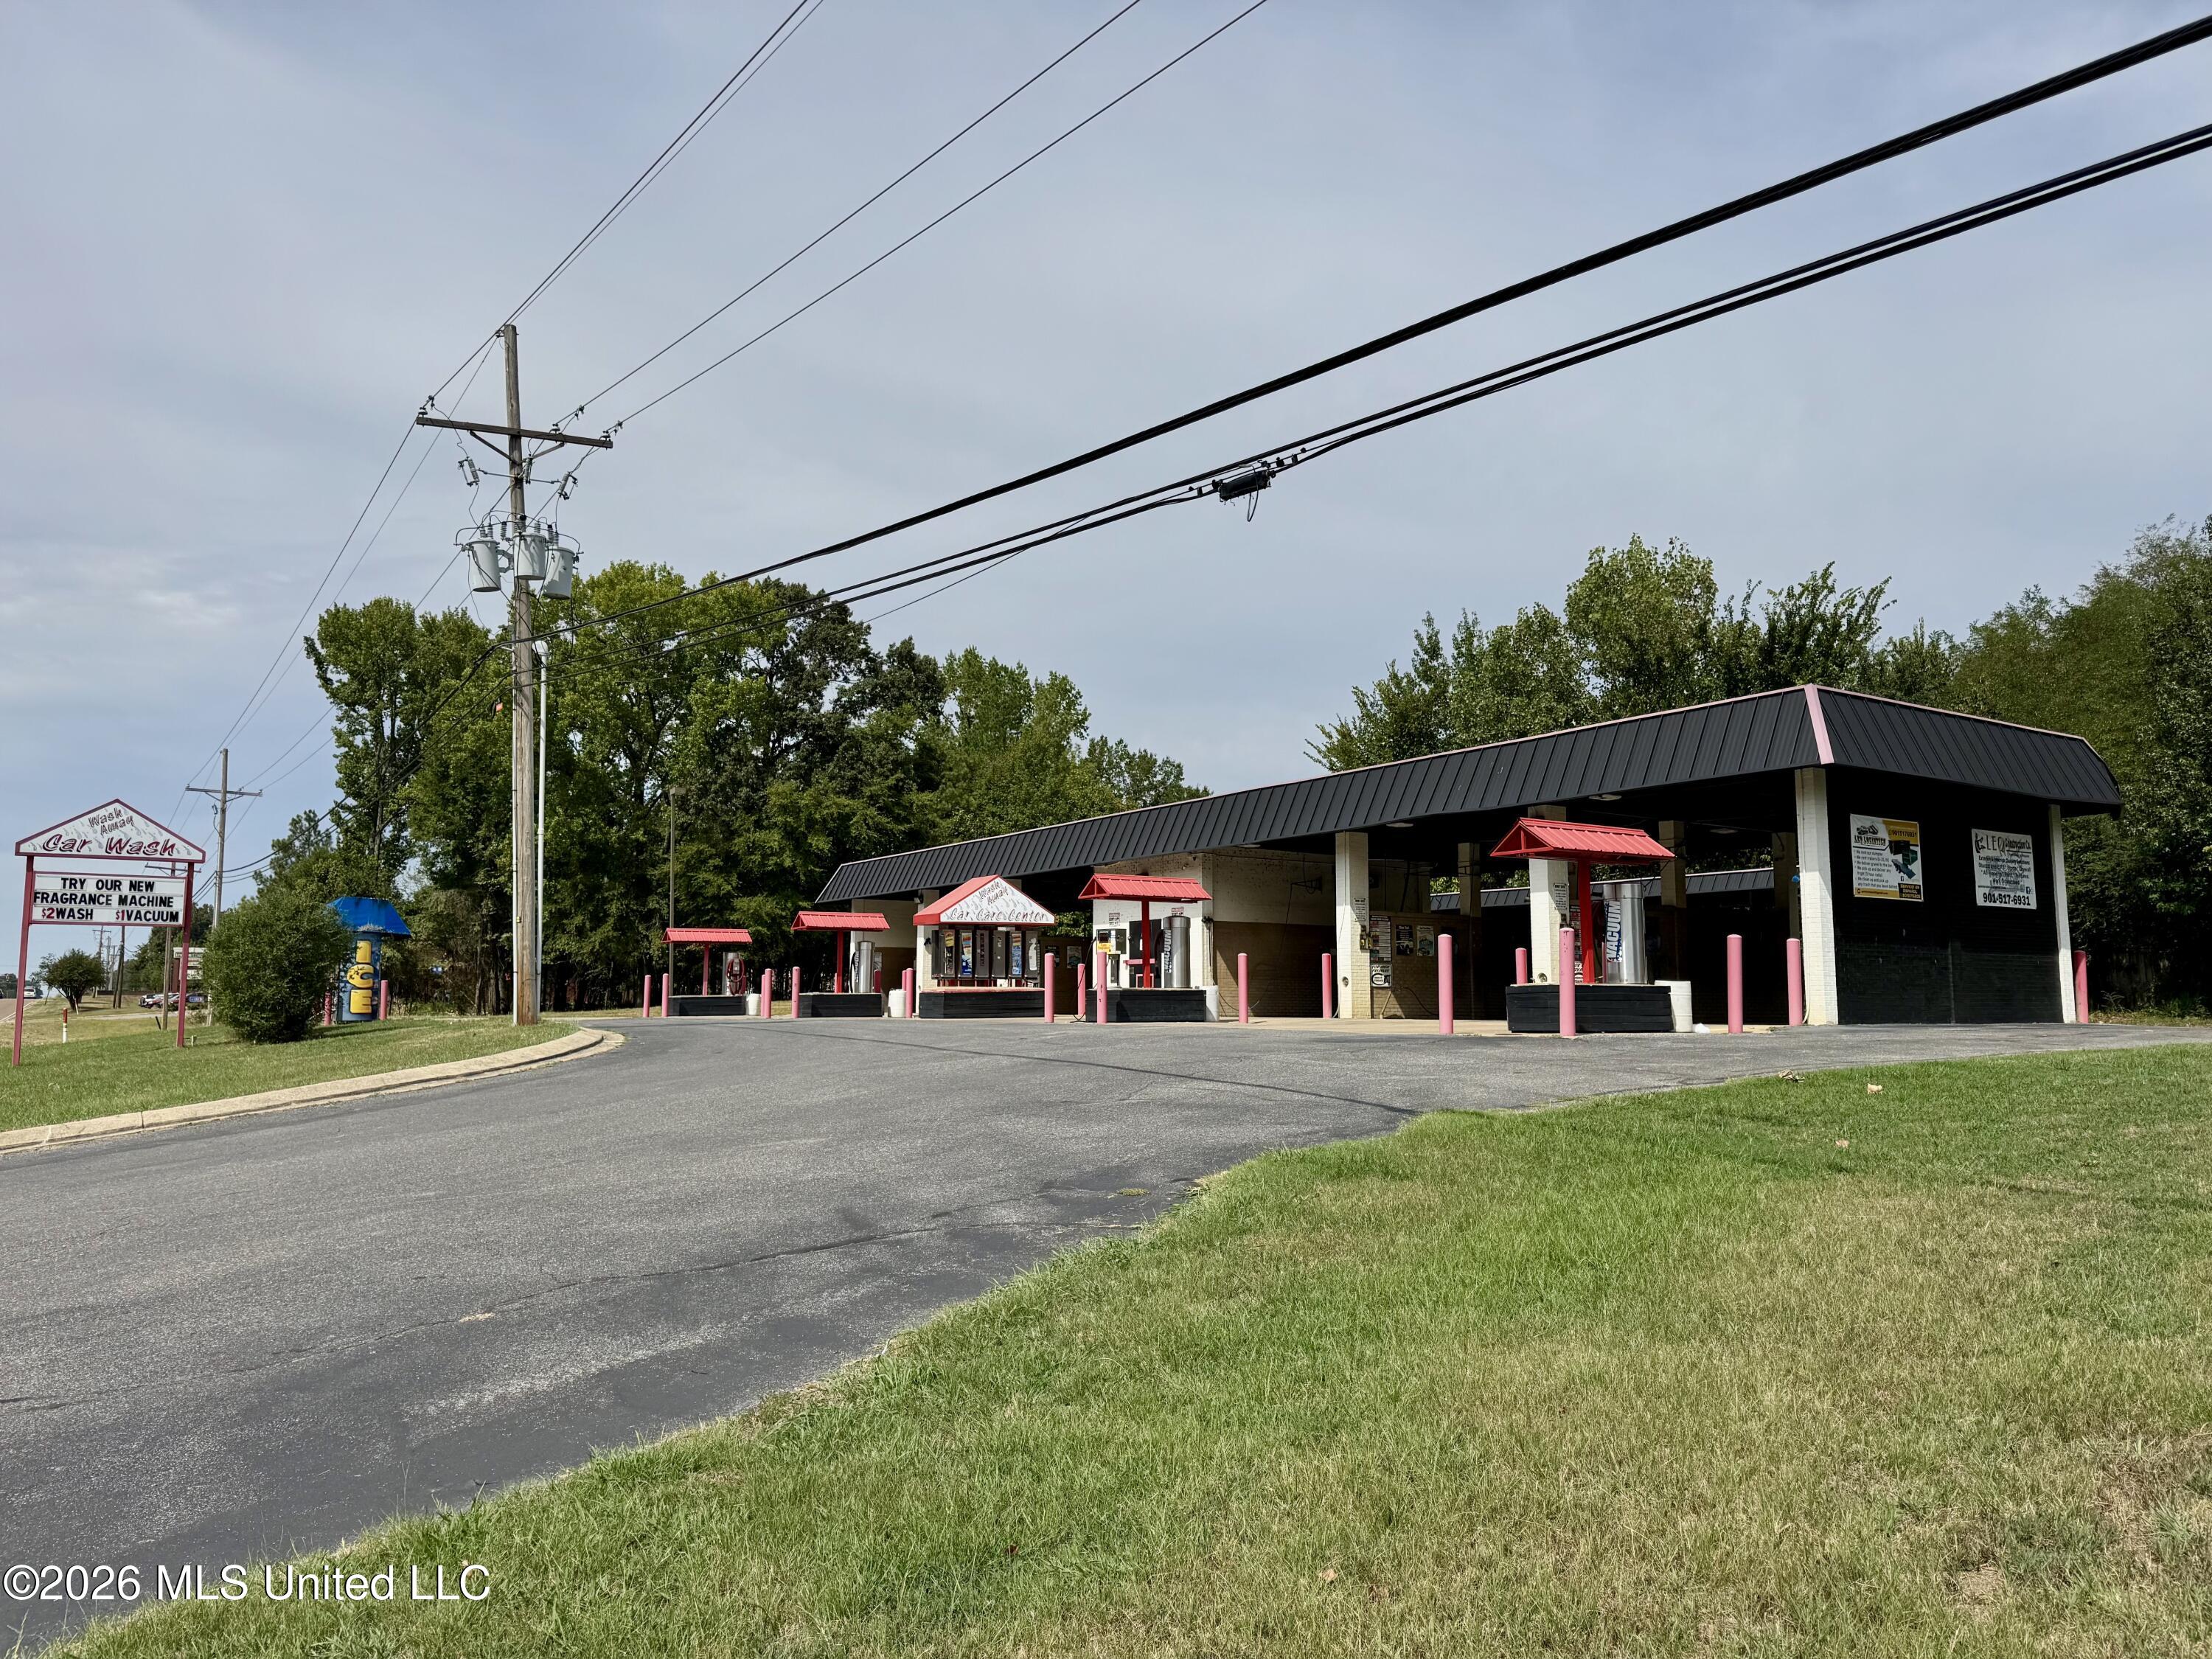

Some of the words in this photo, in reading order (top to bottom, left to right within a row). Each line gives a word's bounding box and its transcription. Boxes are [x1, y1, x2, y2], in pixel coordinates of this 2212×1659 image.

[88, 807, 122, 828] Wash
[100, 815, 134, 836] Away
[42, 833, 93, 853] Car
[105, 837, 176, 857] Wash
[61, 877, 86, 890] TRY
[96, 880, 122, 891] OUR
[129, 880, 155, 892] NEW
[34, 891, 112, 906] FRAGRANCE
[118, 894, 173, 908] MACHINE
[1983, 892, 2031, 906] 901-517-6931
[1606, 901, 1621, 959] VACUUM
[347, 940, 375, 1014] ICE
